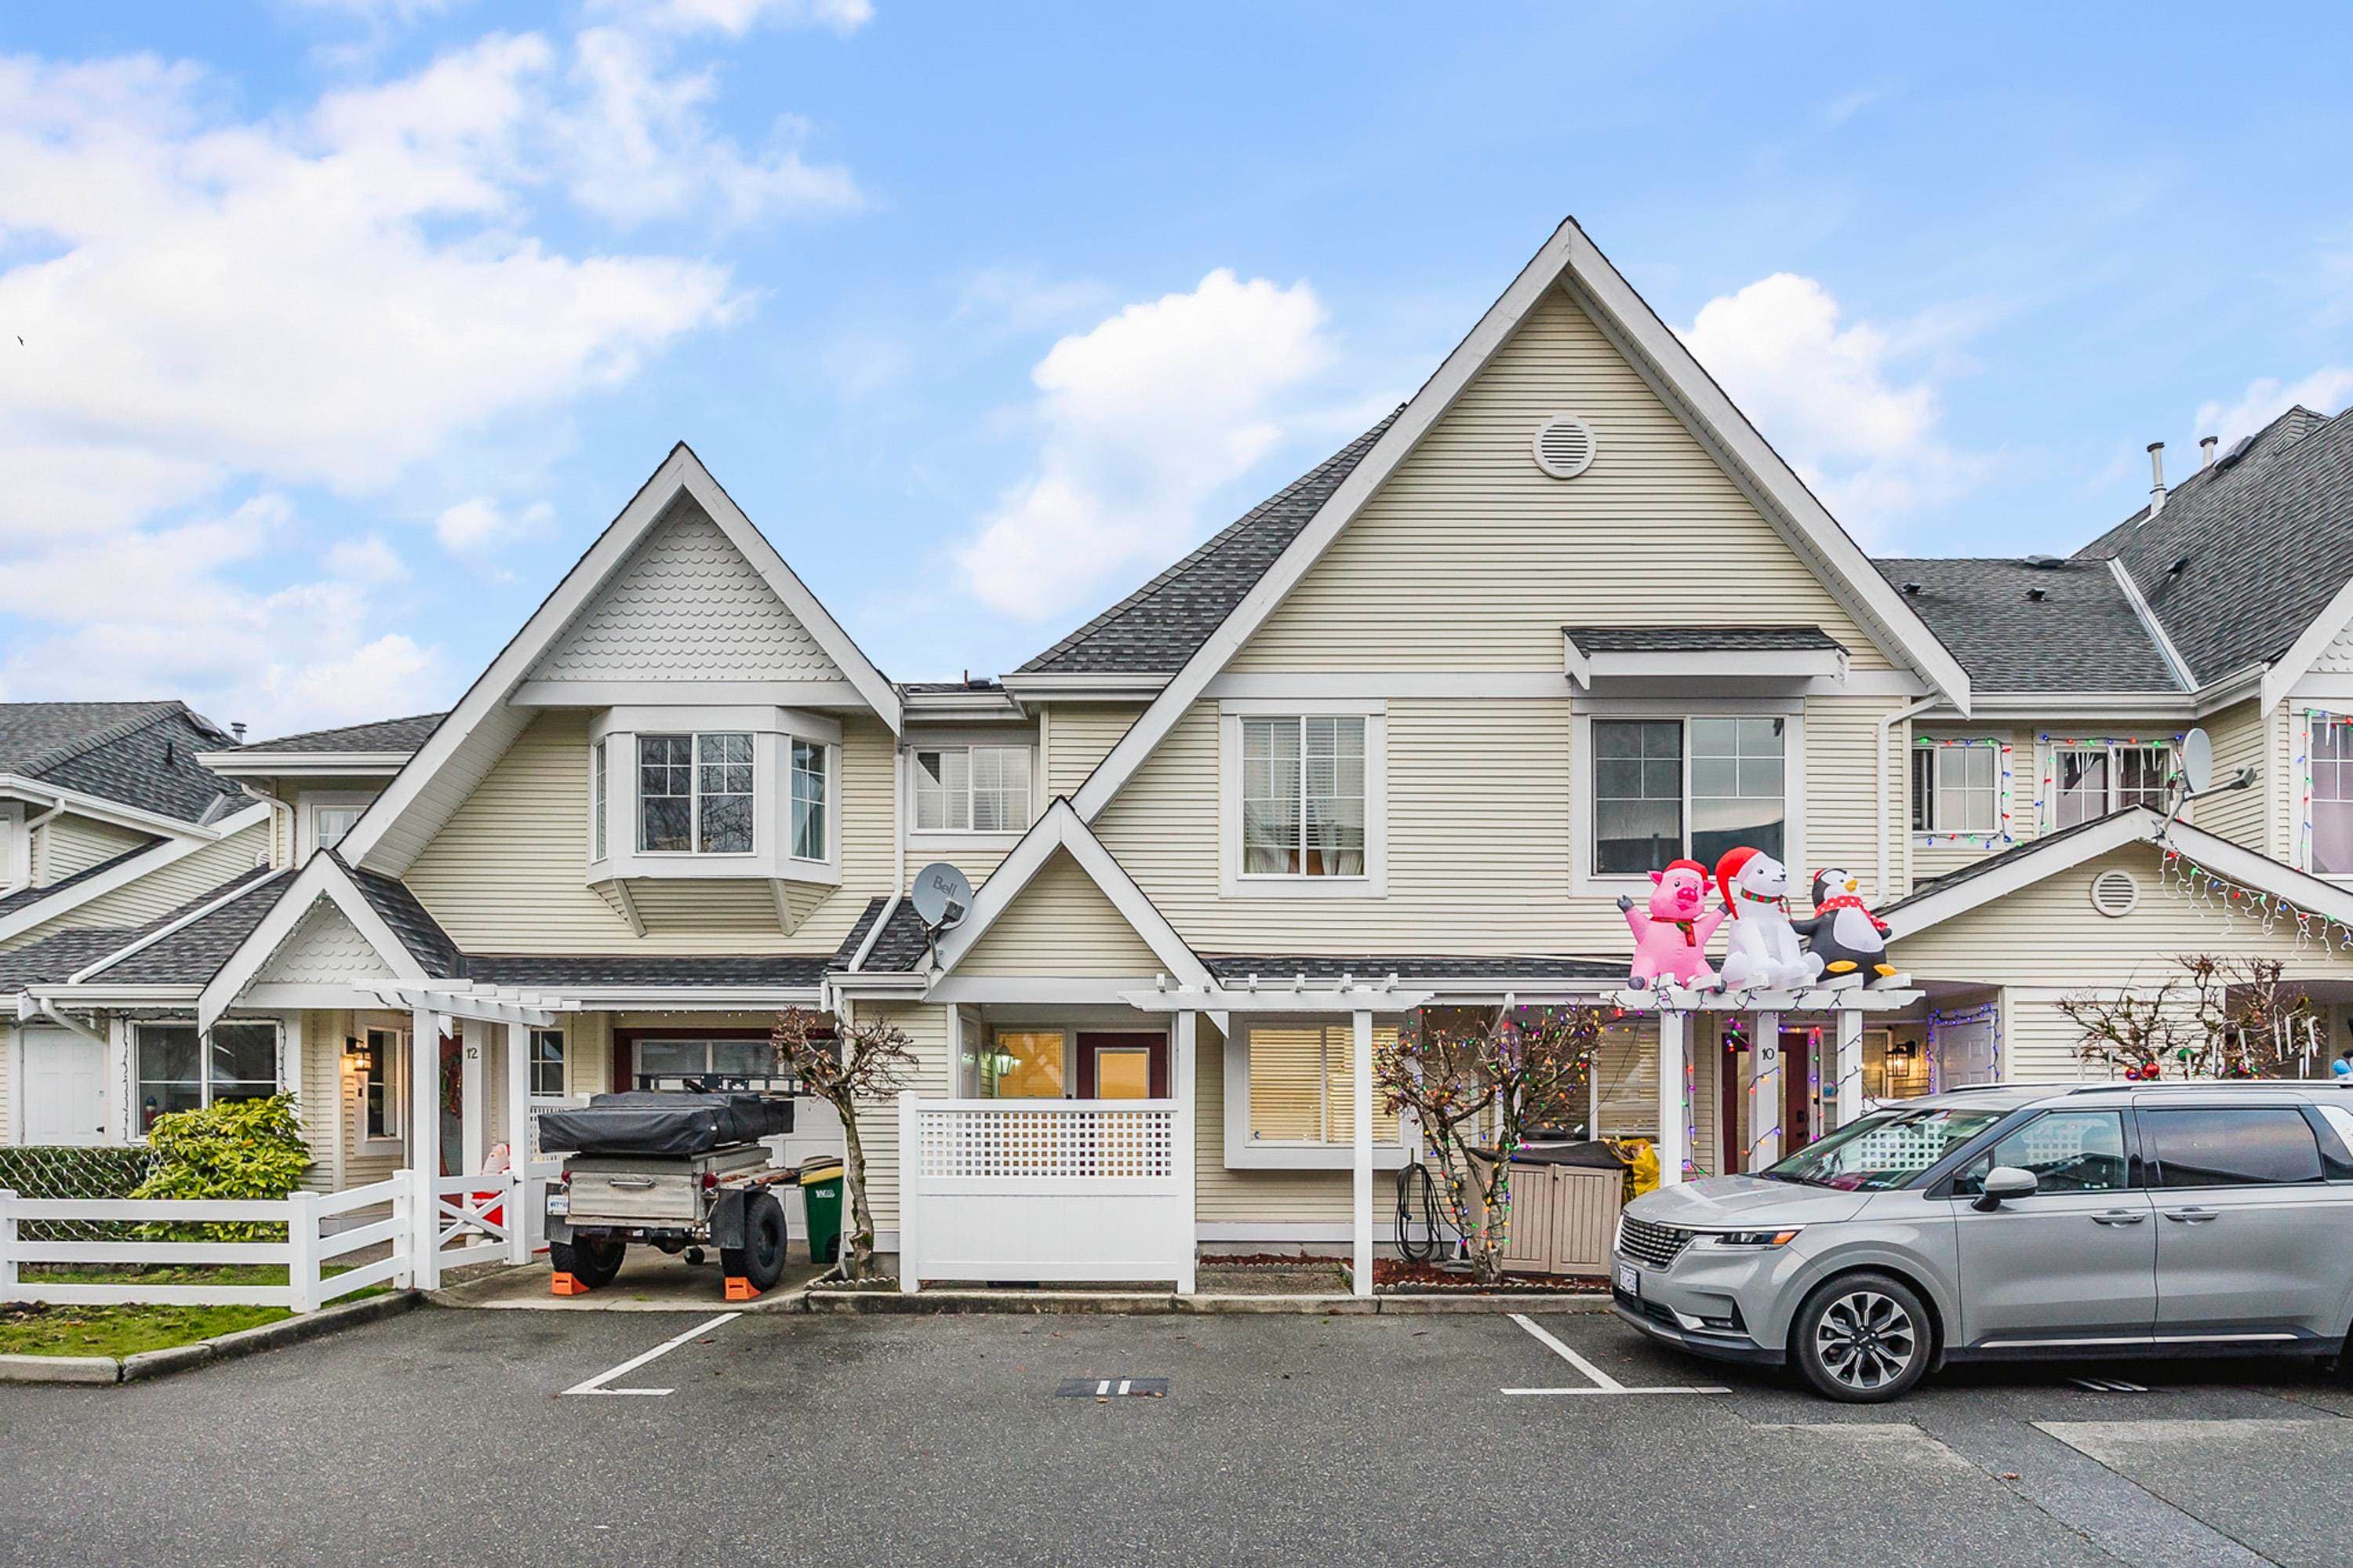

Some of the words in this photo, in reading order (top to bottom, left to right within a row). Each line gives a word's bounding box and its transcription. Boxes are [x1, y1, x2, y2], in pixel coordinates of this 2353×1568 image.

[933, 875, 958, 897] Bell
[466, 1047, 478, 1060] 12
[1762, 1047, 1775, 1060] 10
